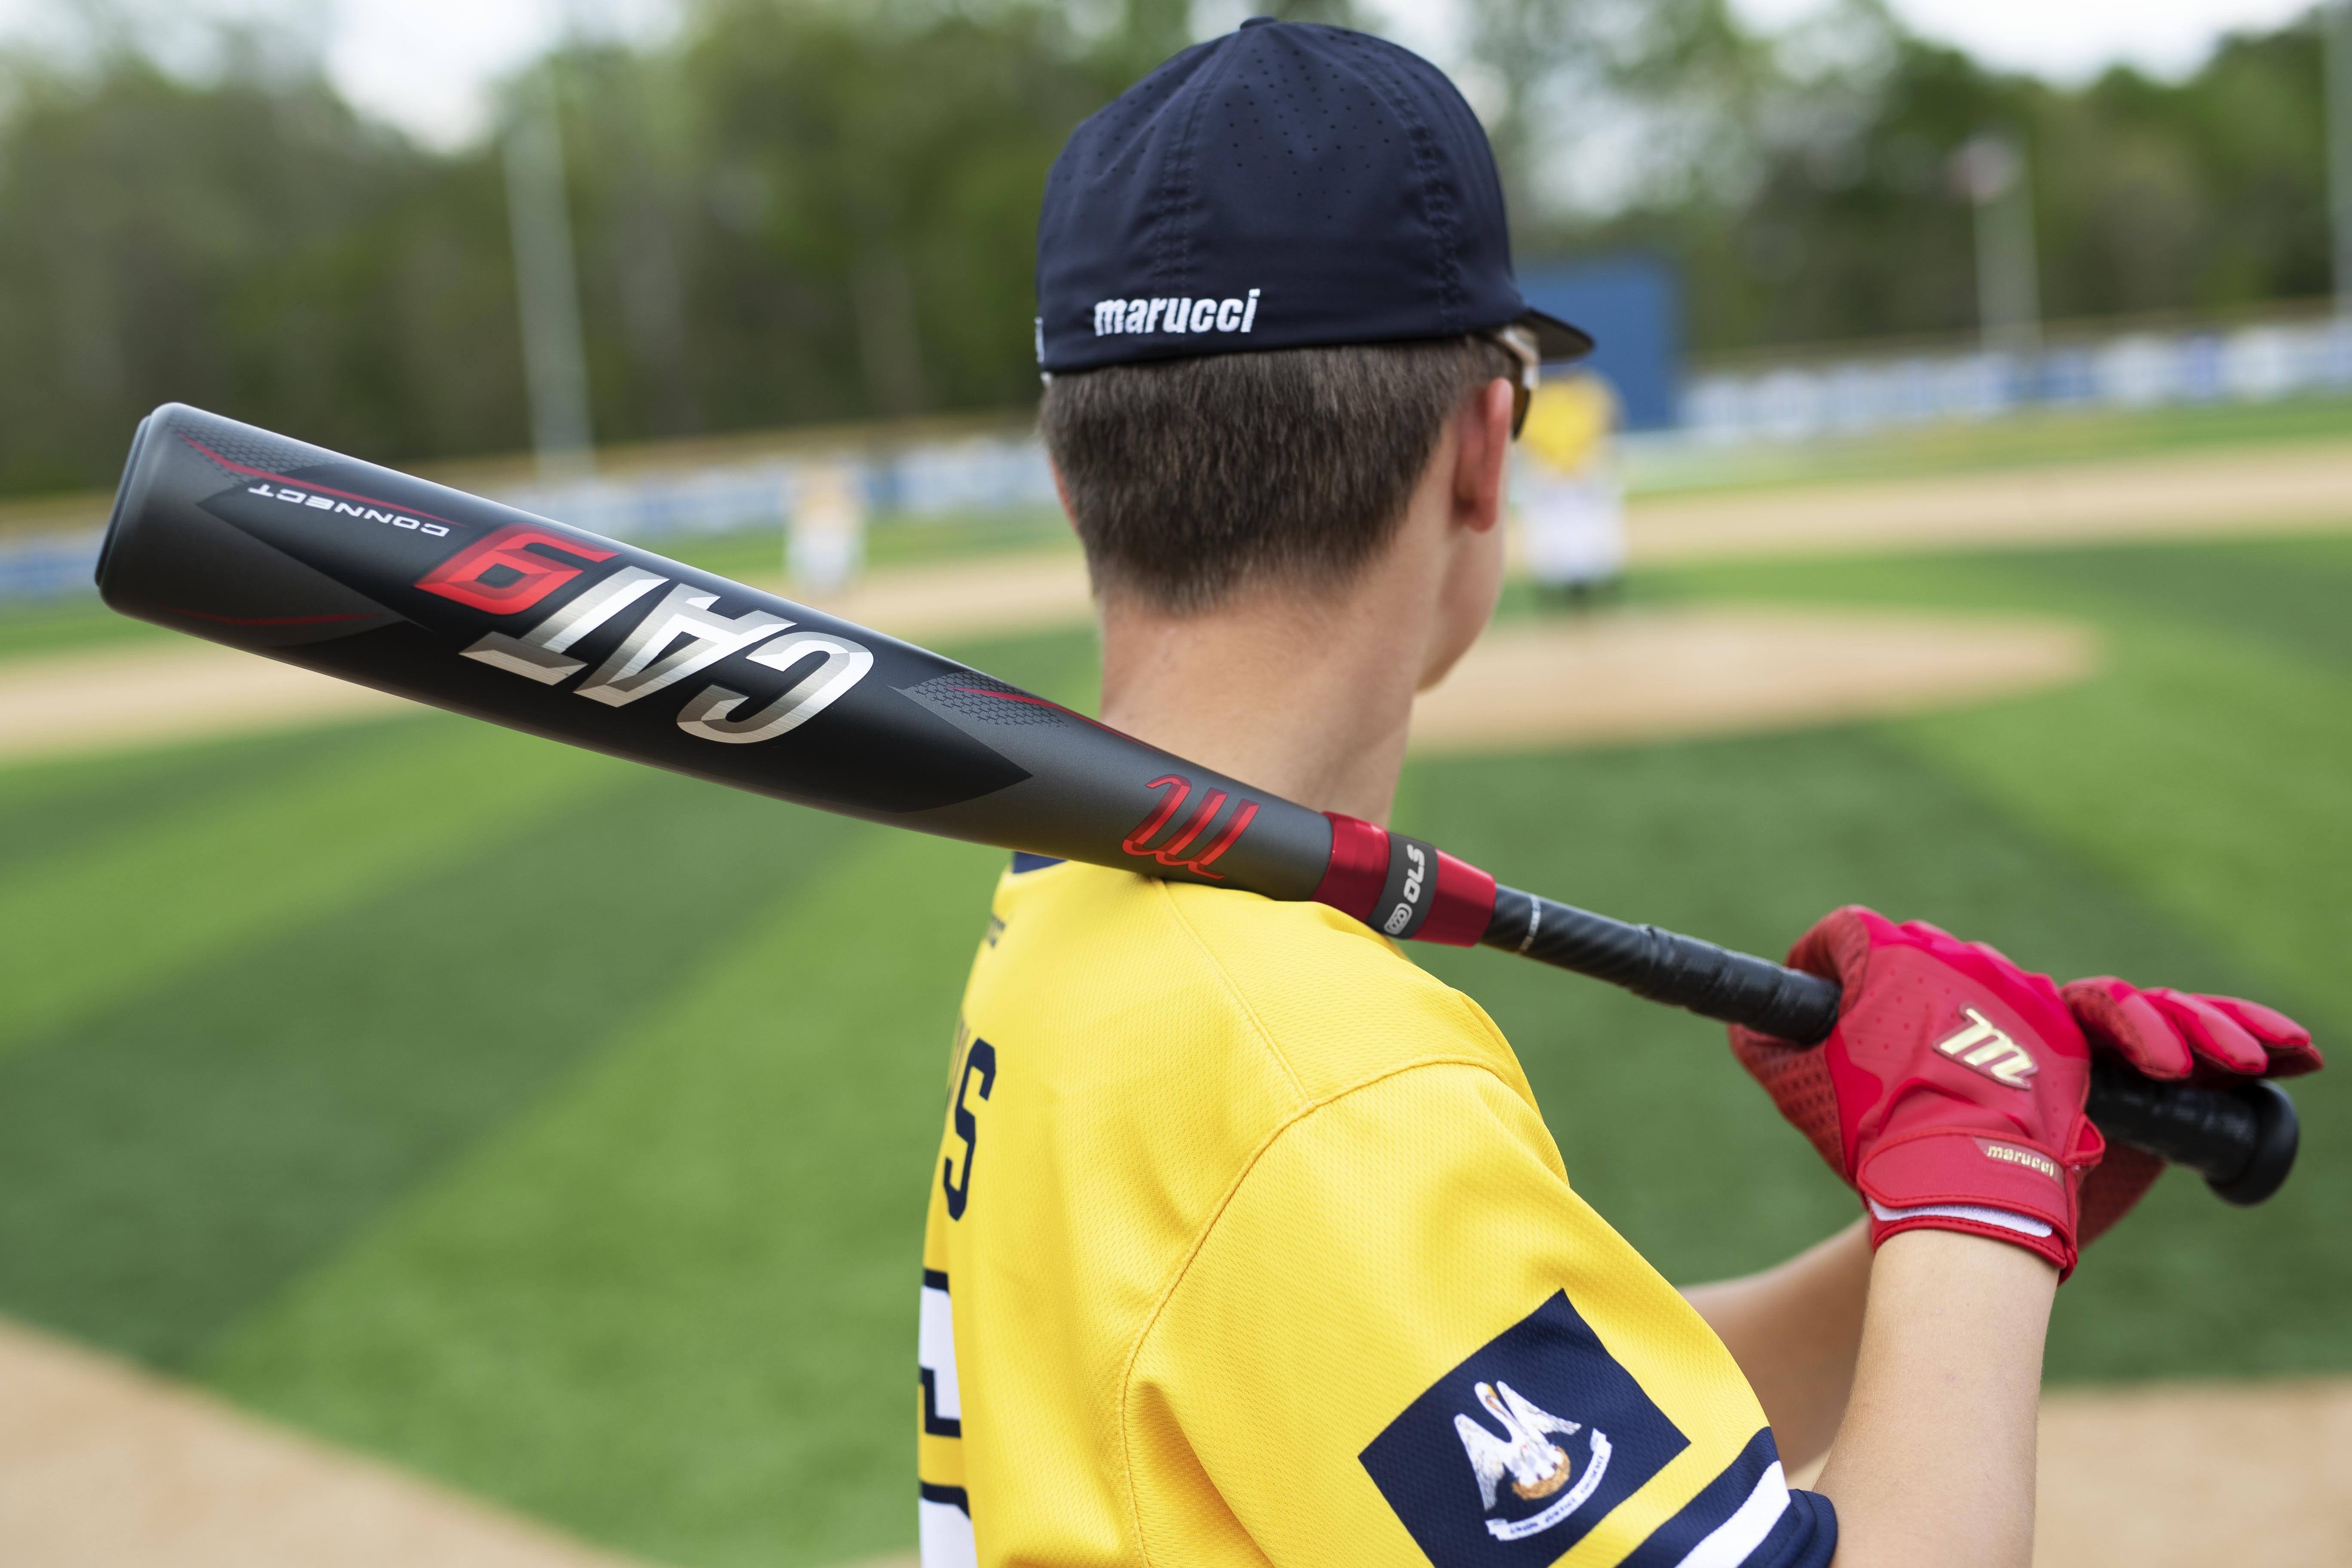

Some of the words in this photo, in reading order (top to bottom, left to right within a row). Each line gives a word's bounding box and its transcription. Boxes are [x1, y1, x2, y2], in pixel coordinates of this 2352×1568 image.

[1094, 288, 1261, 337] marucci
[248, 484, 450, 537] CONNECT
[1987, 1145, 2055, 1177] marucci
